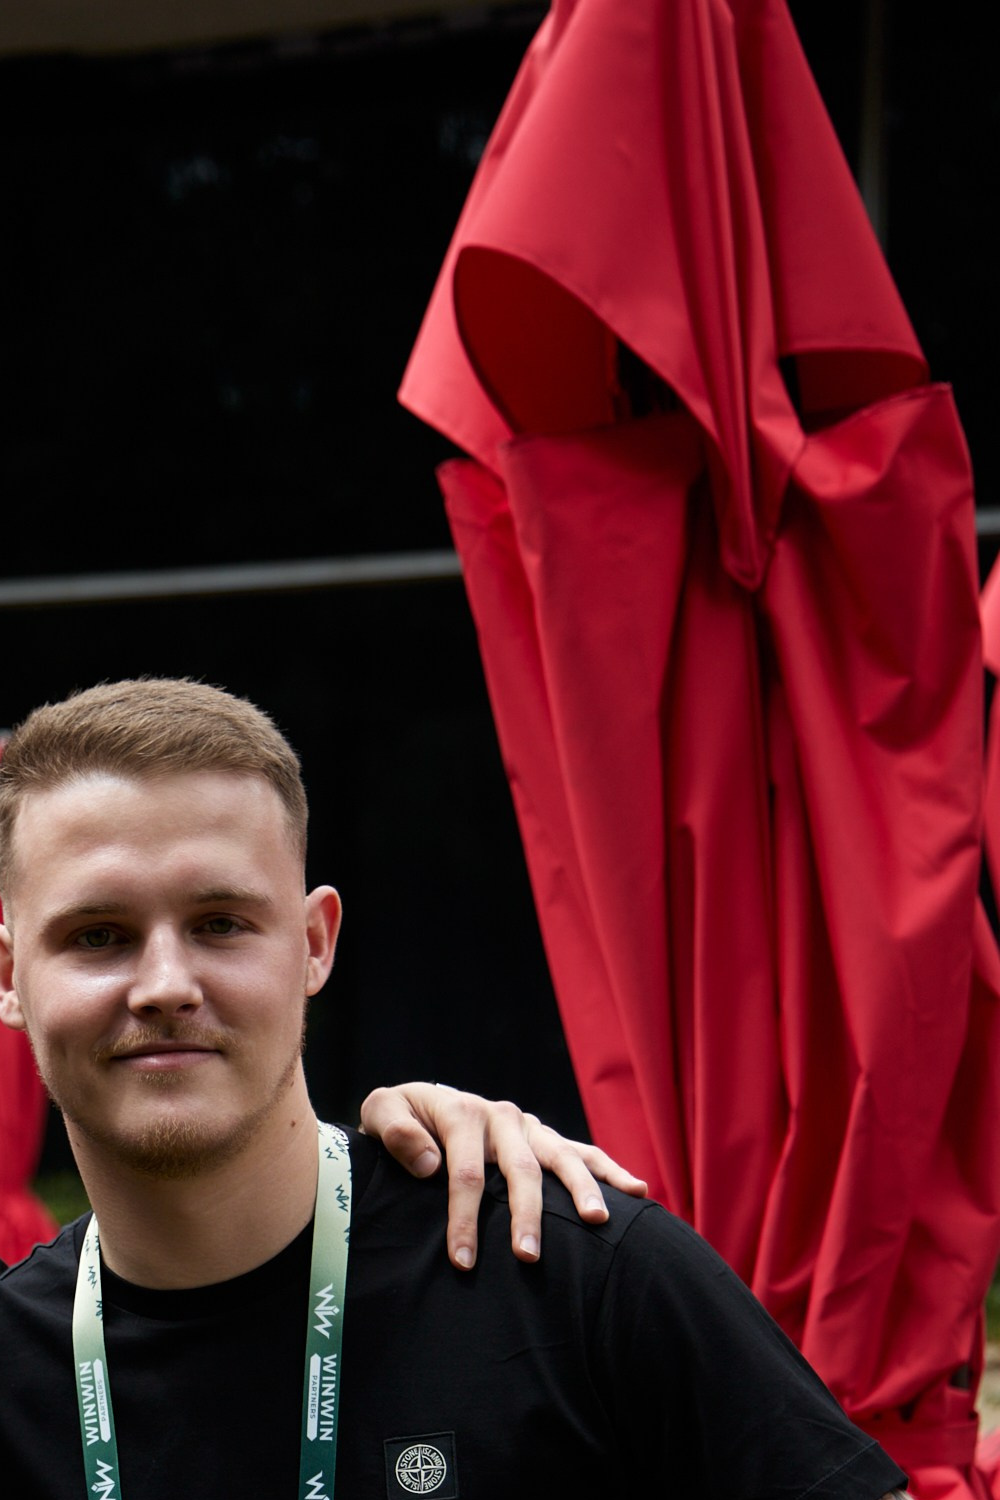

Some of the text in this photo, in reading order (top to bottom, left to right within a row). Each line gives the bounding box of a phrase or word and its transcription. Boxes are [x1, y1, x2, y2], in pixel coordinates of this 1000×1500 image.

[79, 1360, 100, 1447] WINWIN
[97, 1379, 107, 1422] PARTNERS
[309, 1375, 318, 1420] PARTNERS
[319, 1353, 338, 1441] WINWIN
[400, 1447, 443, 1469] STONE ISLAND
[399, 1470, 442, 1491] STONE ISLAND
